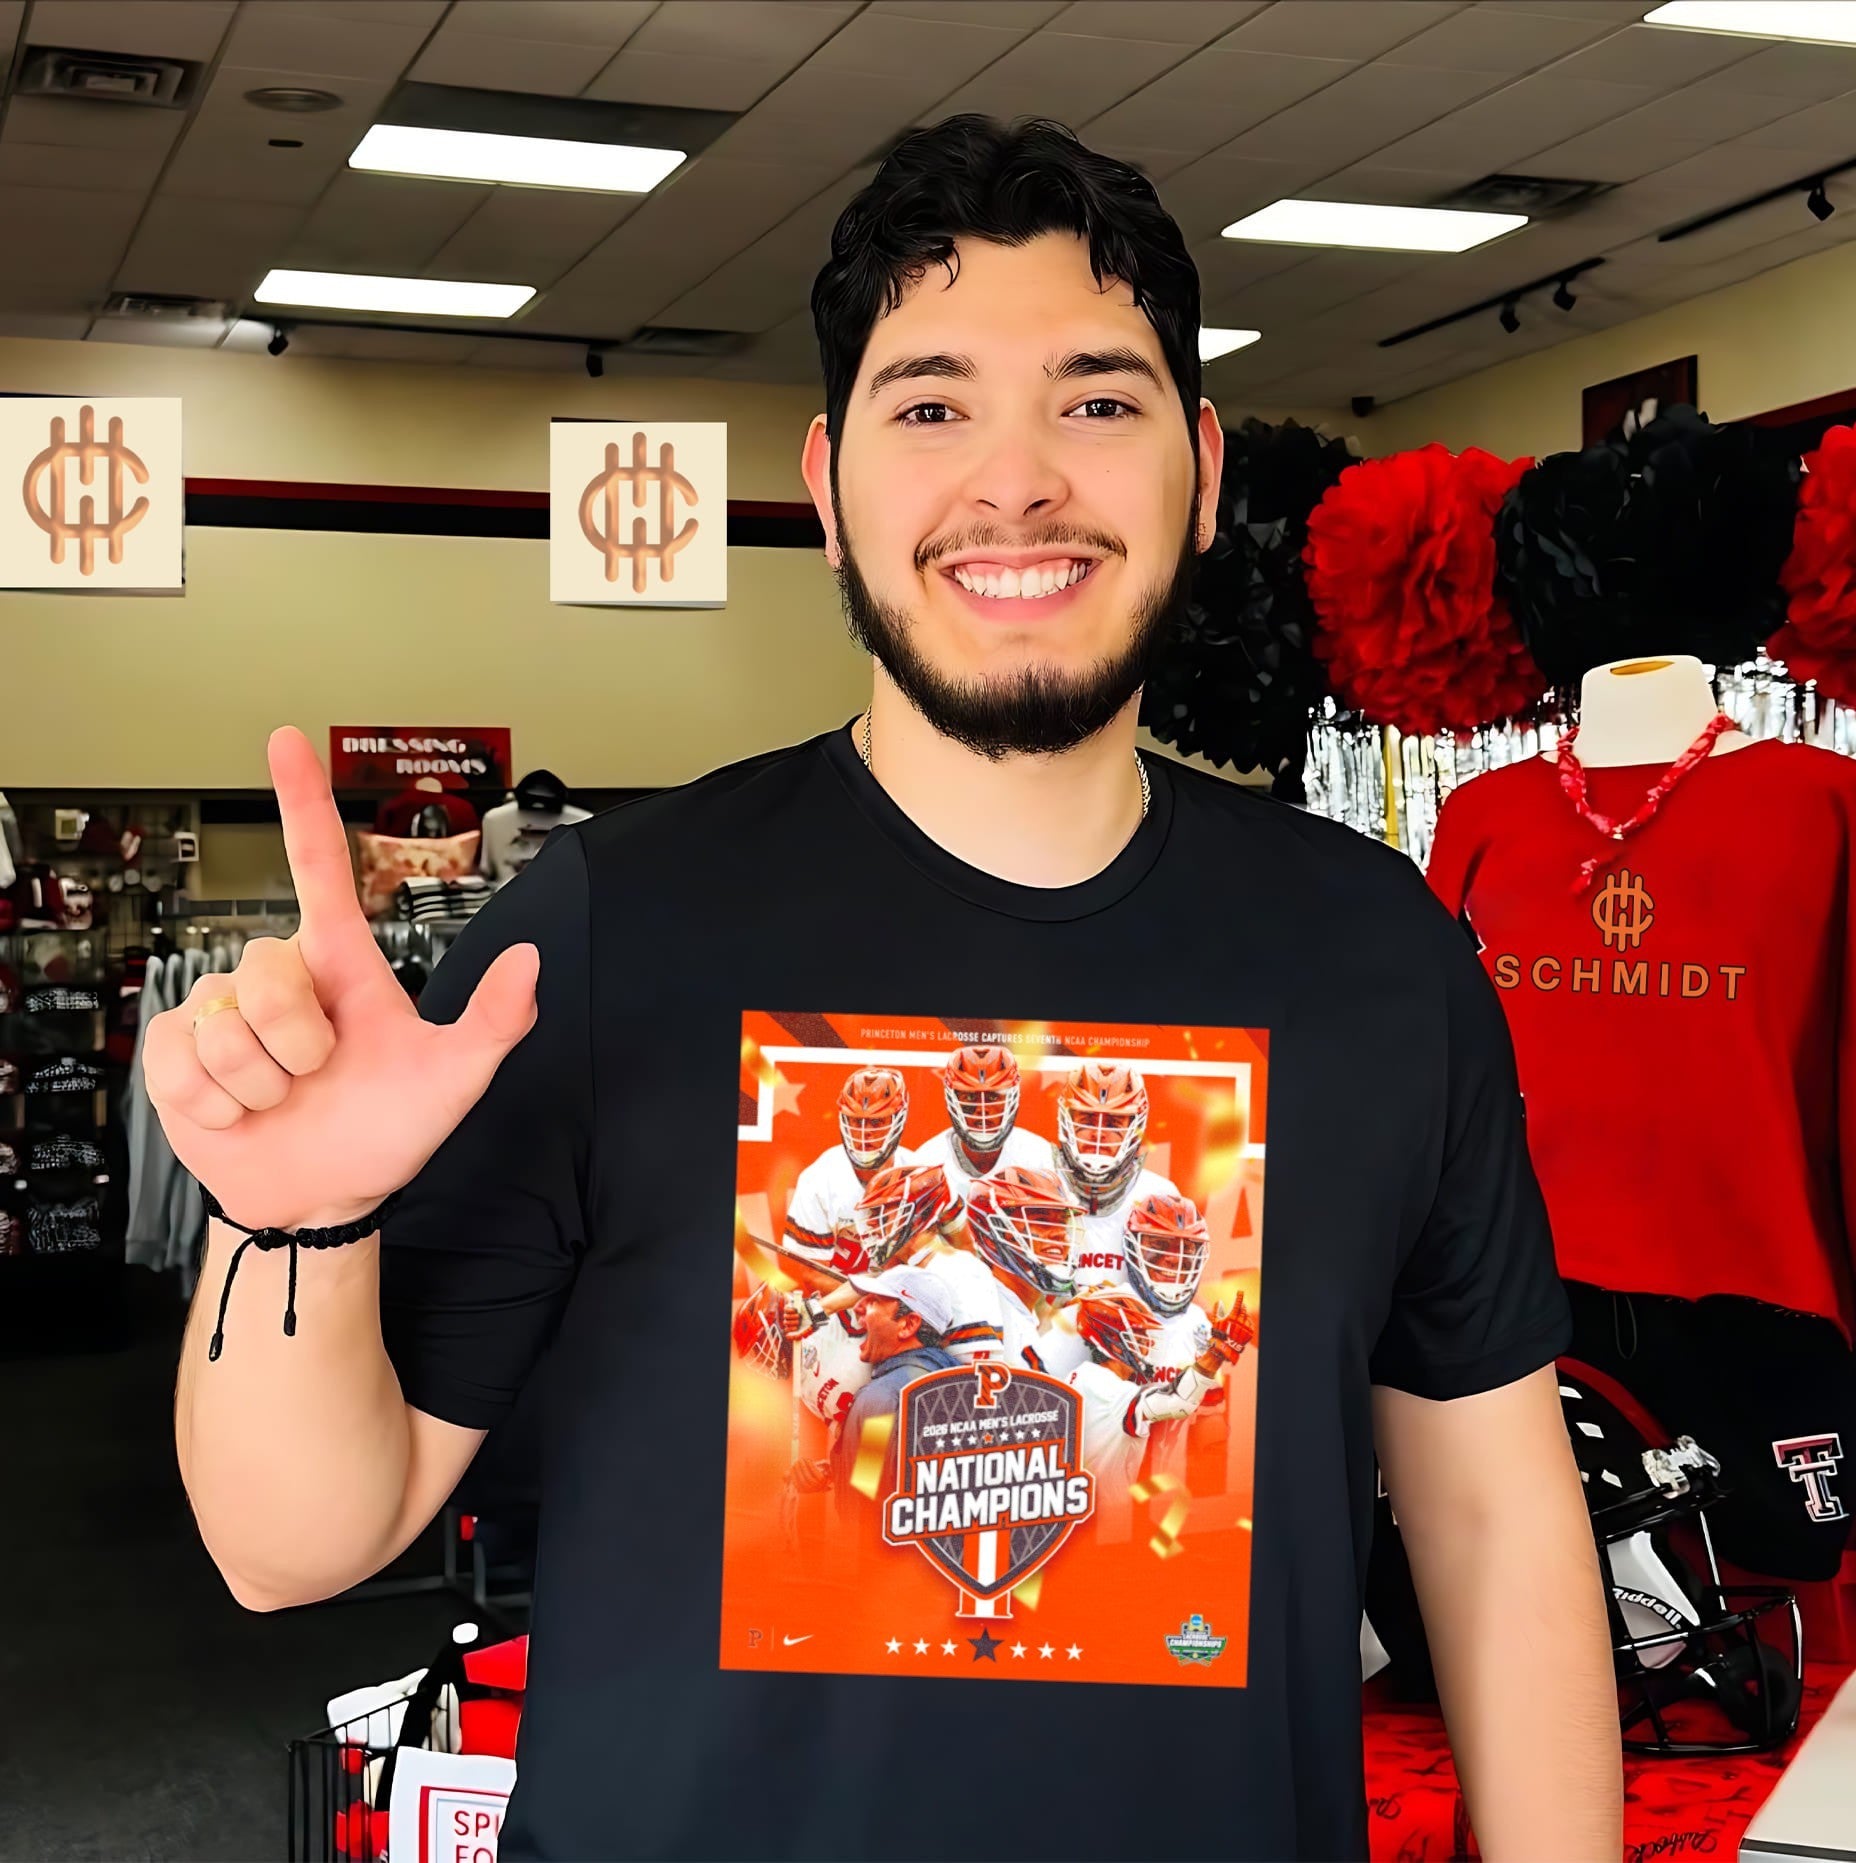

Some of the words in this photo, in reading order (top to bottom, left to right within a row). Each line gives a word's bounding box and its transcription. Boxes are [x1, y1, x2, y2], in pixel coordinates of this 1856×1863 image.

[342, 737, 466, 753] DRESSING
[396, 758, 487, 775] ROOMS
[1494, 953, 1746, 1001] SCHMIDT
[861, 1028, 906, 1039] PRINCETON
[909, 1030, 935, 1040] MEN'S
[937, 1031, 979, 1042] LACROSSE
[981, 1032, 1023, 1044] CAPTURES
[1026, 1034, 1061, 1045] SEVENTH
[1065, 1036, 1086, 1046] NCAA
[1088, 1036, 1151, 1048] CHAMPIONSHIP
[973, 1361, 1012, 1409] P
[922, 1424, 948, 1438] 2026
[950, 1421, 977, 1436] NCAA
[978, 1416, 1008, 1431] MEN'S
[1009, 1409, 1059, 1429] LACROSSE
[916, 1444, 1066, 1496] NATIONAL
[890, 1476, 1089, 1537] CHAMPIONS
